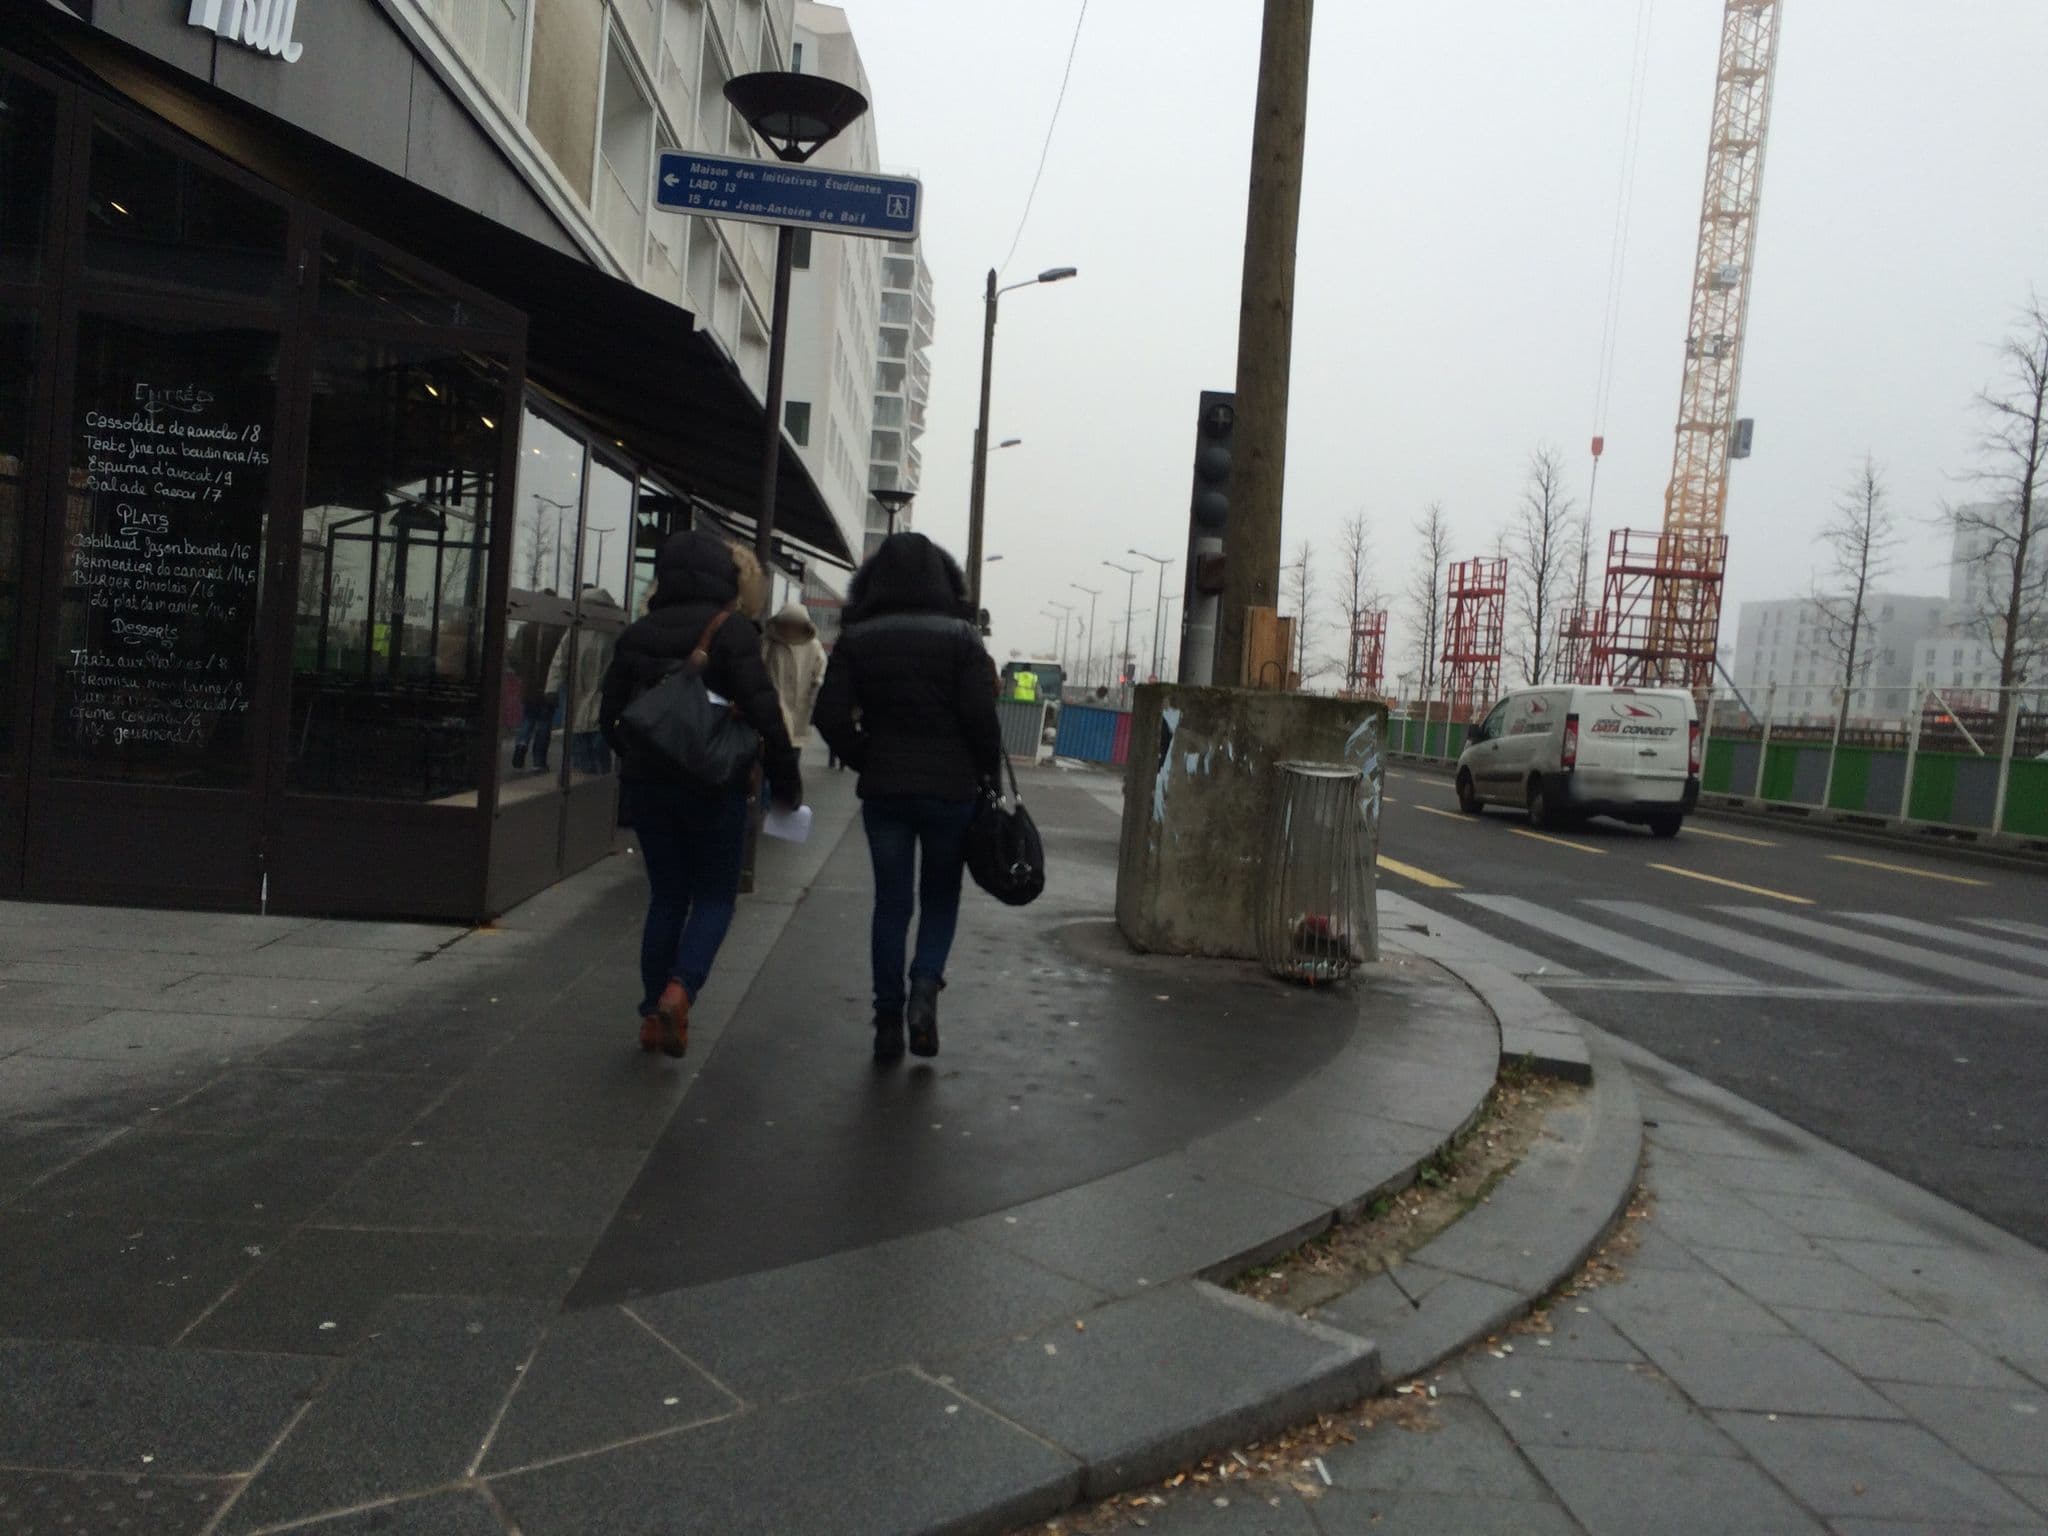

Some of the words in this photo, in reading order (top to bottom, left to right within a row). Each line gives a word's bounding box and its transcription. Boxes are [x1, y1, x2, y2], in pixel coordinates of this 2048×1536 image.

[689, 163, 728, 177] Maison
[736, 169, 754, 180] des
[762, 172, 817, 187] Initiatives
[689, 179, 718, 191] LABO
[725, 182, 737, 193] 13
[688, 194, 701, 205] 15
[708, 199, 728, 208] rue
[735, 200, 812, 217] Jean-Antoine
[819, 209, 834, 220] de
[157, 445, 177, 456] au
[88, 455, 149, 475] Espuma
[116, 503, 169, 526] PLATS
[111, 617, 179, 640] Desserts
[1591, 722, 1620, 734] DATA
[1622, 725, 1680, 736] CONNECT
